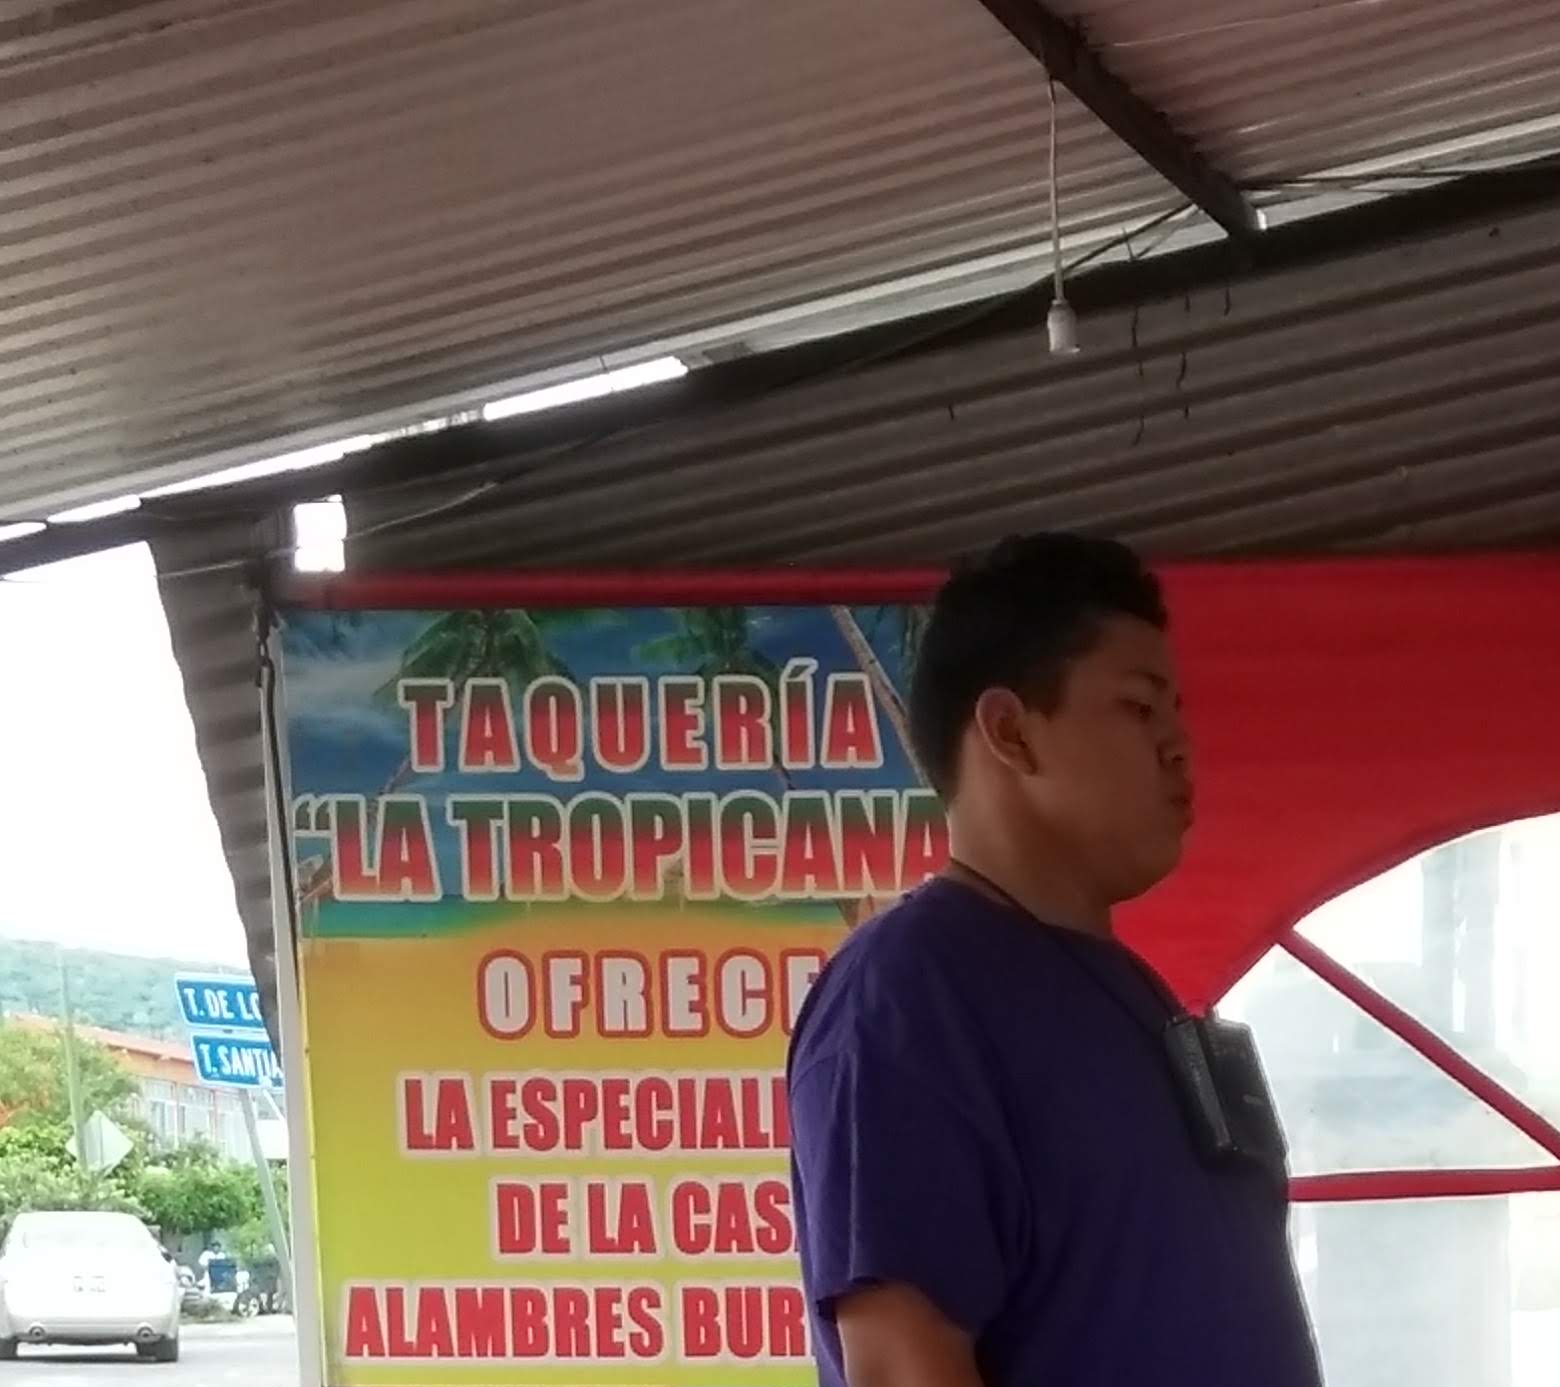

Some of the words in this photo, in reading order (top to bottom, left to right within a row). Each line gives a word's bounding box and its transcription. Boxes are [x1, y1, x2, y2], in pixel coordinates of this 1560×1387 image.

[399, 656, 884, 782] TAQUERÍA
[446, 788, 952, 902] TROPICANA
[204, 988, 235, 1020] DE
[404, 1079, 474, 1150] LA
[490, 1076, 791, 1152] ESPECIALI
[496, 1183, 569, 1254] DE
[587, 1183, 657, 1254] LA
[671, 1181, 798, 1255] CAS
[345, 1286, 663, 1358] ALAMBRES
[682, 1286, 806, 1358] BUR
